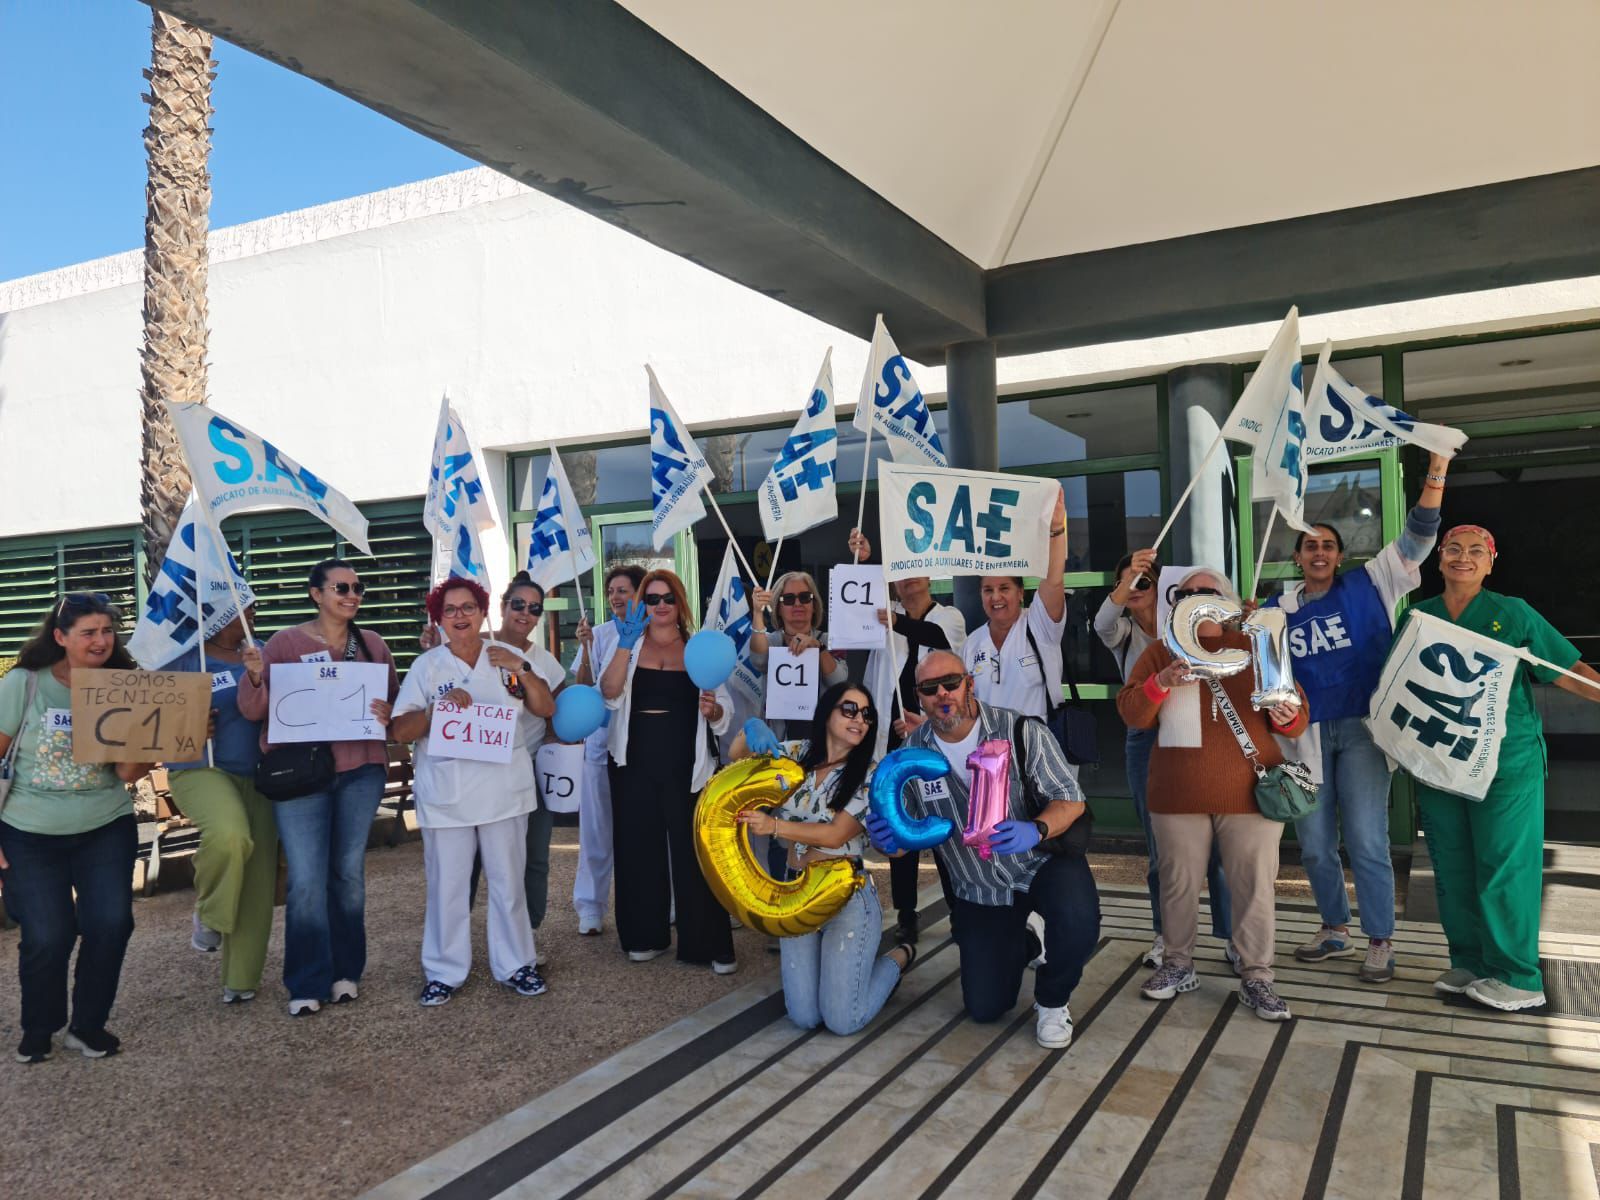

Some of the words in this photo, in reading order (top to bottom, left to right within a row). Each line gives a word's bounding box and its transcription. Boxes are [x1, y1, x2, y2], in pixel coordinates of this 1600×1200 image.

[1238, 417, 1263, 433] SINDIC
[882, 419, 917, 443] AUXILIARES
[923, 448, 948, 468] ENFERM
[1306, 446, 1335, 456] DICATO
[248, 486, 260, 495] DE
[890, 559, 923, 571] SINDICATO
[924, 558, 934, 567] DE
[935, 559, 973, 569] AUXILIARES
[974, 560, 984, 570] DE
[985, 559, 1029, 570] ENFERMERÍA
[840, 580, 875, 606] C1
[111, 673, 177, 688] SOMOS
[775, 663, 809, 687] C1
[80, 687, 188, 706] TECNICOS
[436, 701, 462, 714] SOY
[474, 705, 514, 721] TCAE
[95, 707, 164, 751] C1
[442, 720, 473, 742] C1
[175, 736, 198, 753] YA
[543, 772, 575, 798] C1
